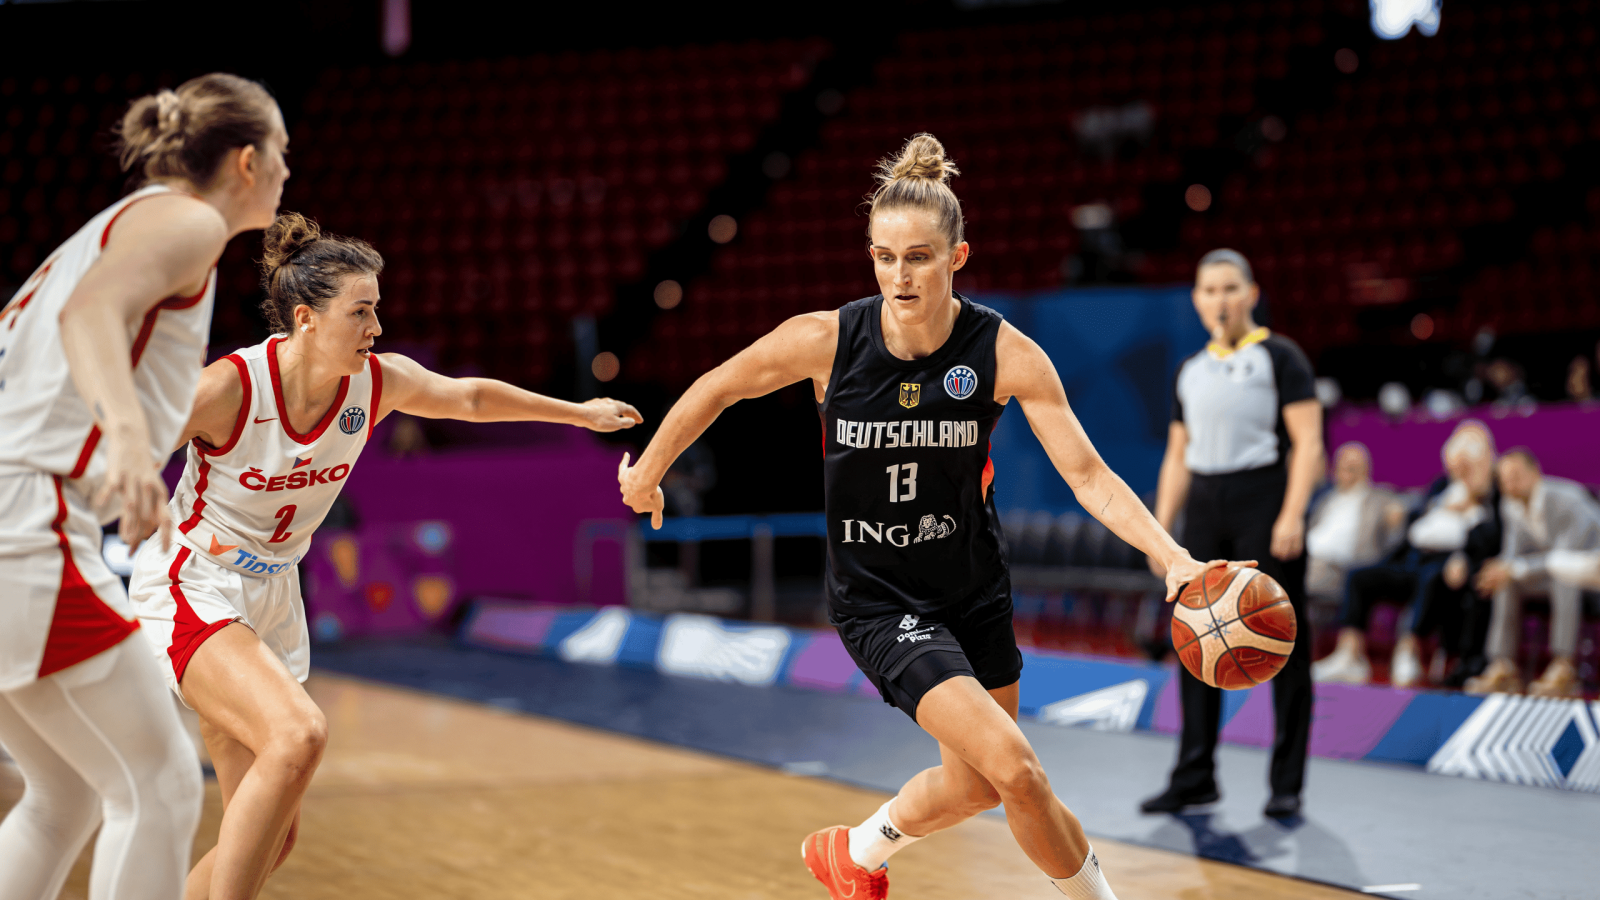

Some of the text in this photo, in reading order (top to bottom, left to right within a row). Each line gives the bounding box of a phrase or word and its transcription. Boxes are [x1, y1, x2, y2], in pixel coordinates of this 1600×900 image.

[836, 418, 979, 449] DEUTSCHLAND
[238, 463, 350, 492] ČESKO
[886, 462, 918, 503] 13
[267, 504, 297, 543] 2
[841, 518, 911, 548] ING
[233, 549, 300, 574] Tips
